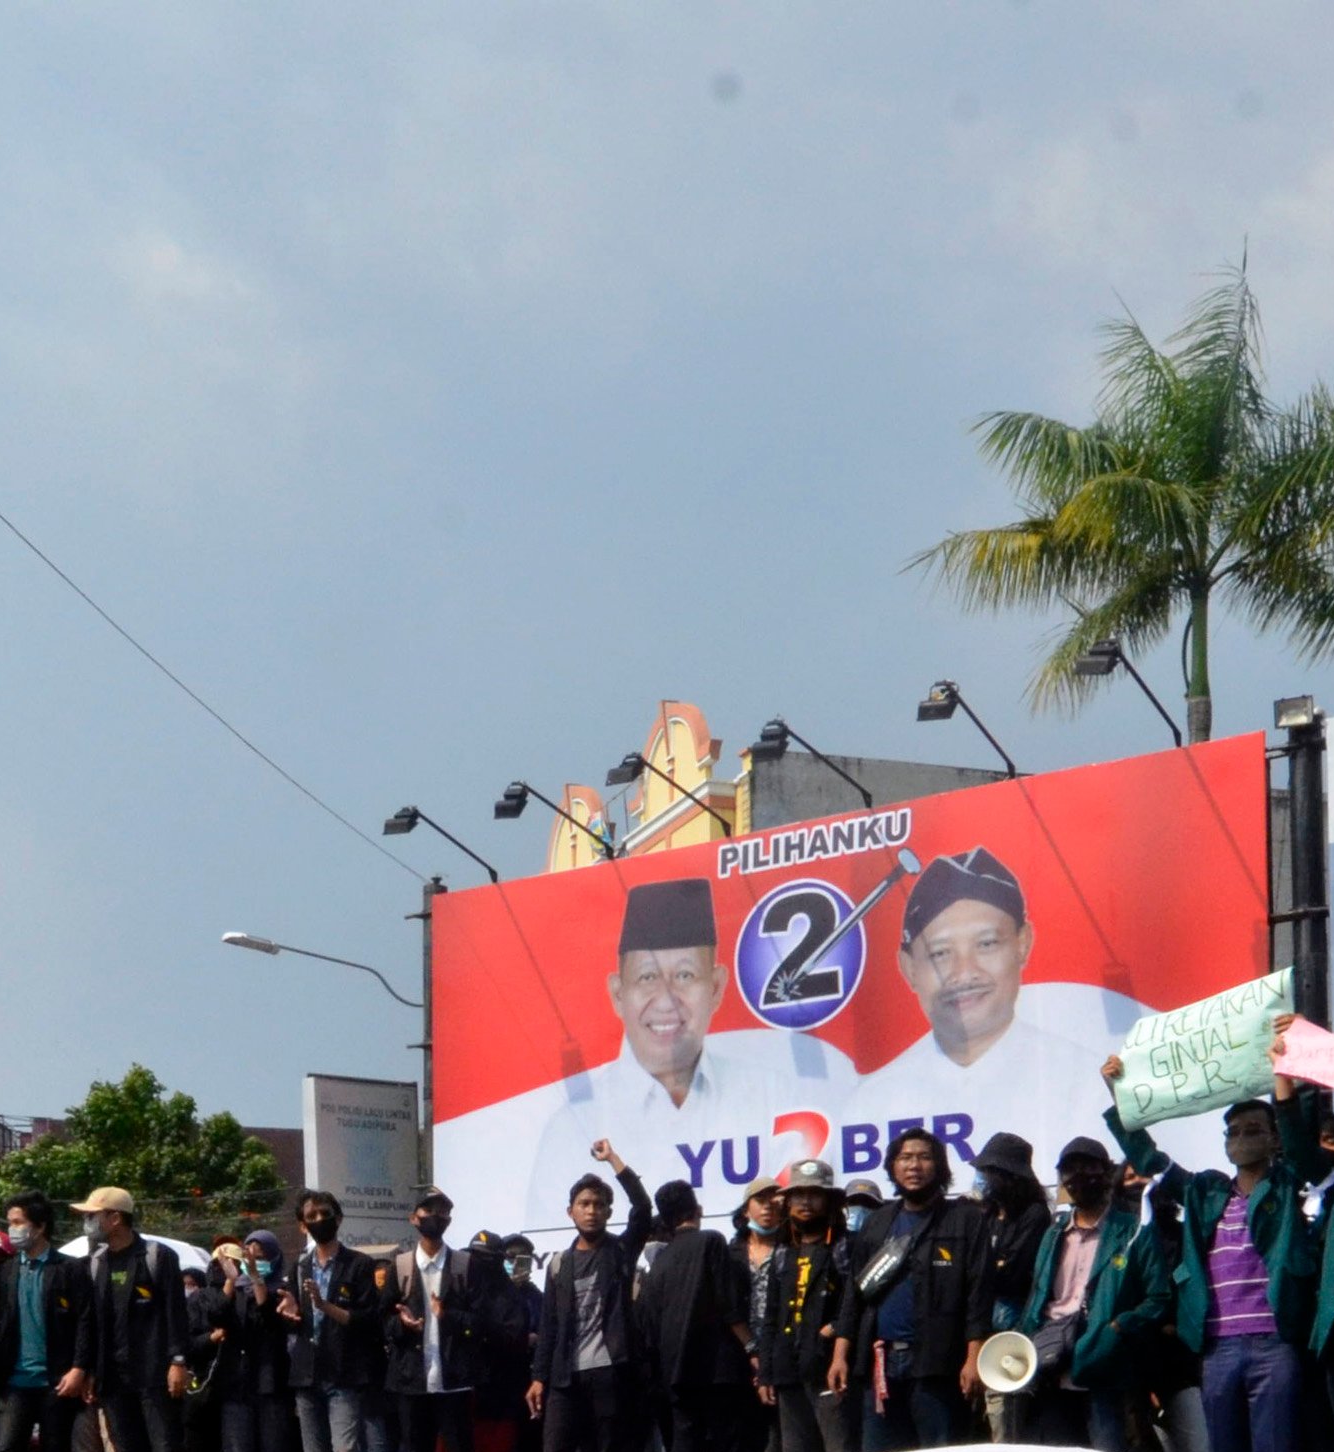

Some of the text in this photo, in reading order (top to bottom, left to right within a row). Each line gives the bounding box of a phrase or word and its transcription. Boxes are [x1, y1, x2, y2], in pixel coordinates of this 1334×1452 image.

[719, 808, 911, 878] PILIHANKU
[760, 890, 846, 1012] 2
[1149, 1022, 1249, 1079] GINJAL
